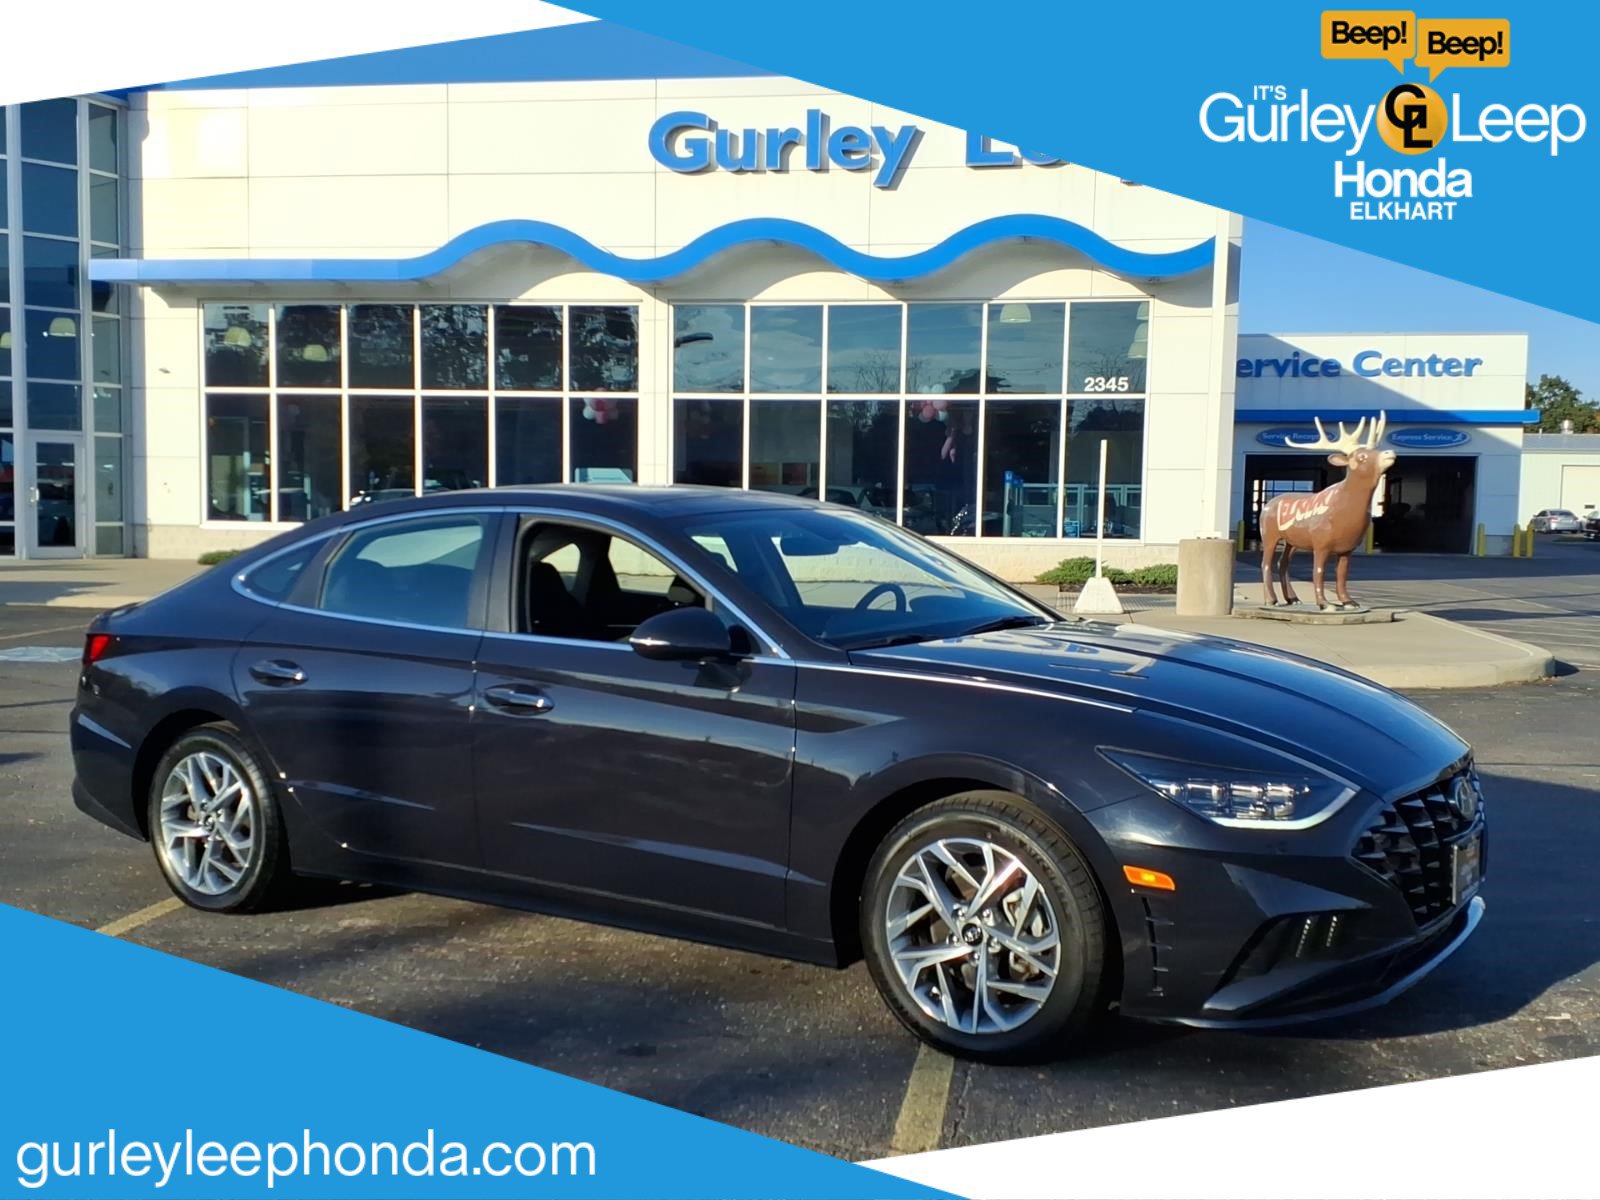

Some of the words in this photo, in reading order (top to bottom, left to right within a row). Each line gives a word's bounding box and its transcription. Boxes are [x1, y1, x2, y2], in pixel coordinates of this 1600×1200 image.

[648, 109, 920, 188] Gurley
[1236, 351, 1342, 378] ervice
[1352, 350, 1483, 378] Center
[1084, 376, 1129, 392] 2345
